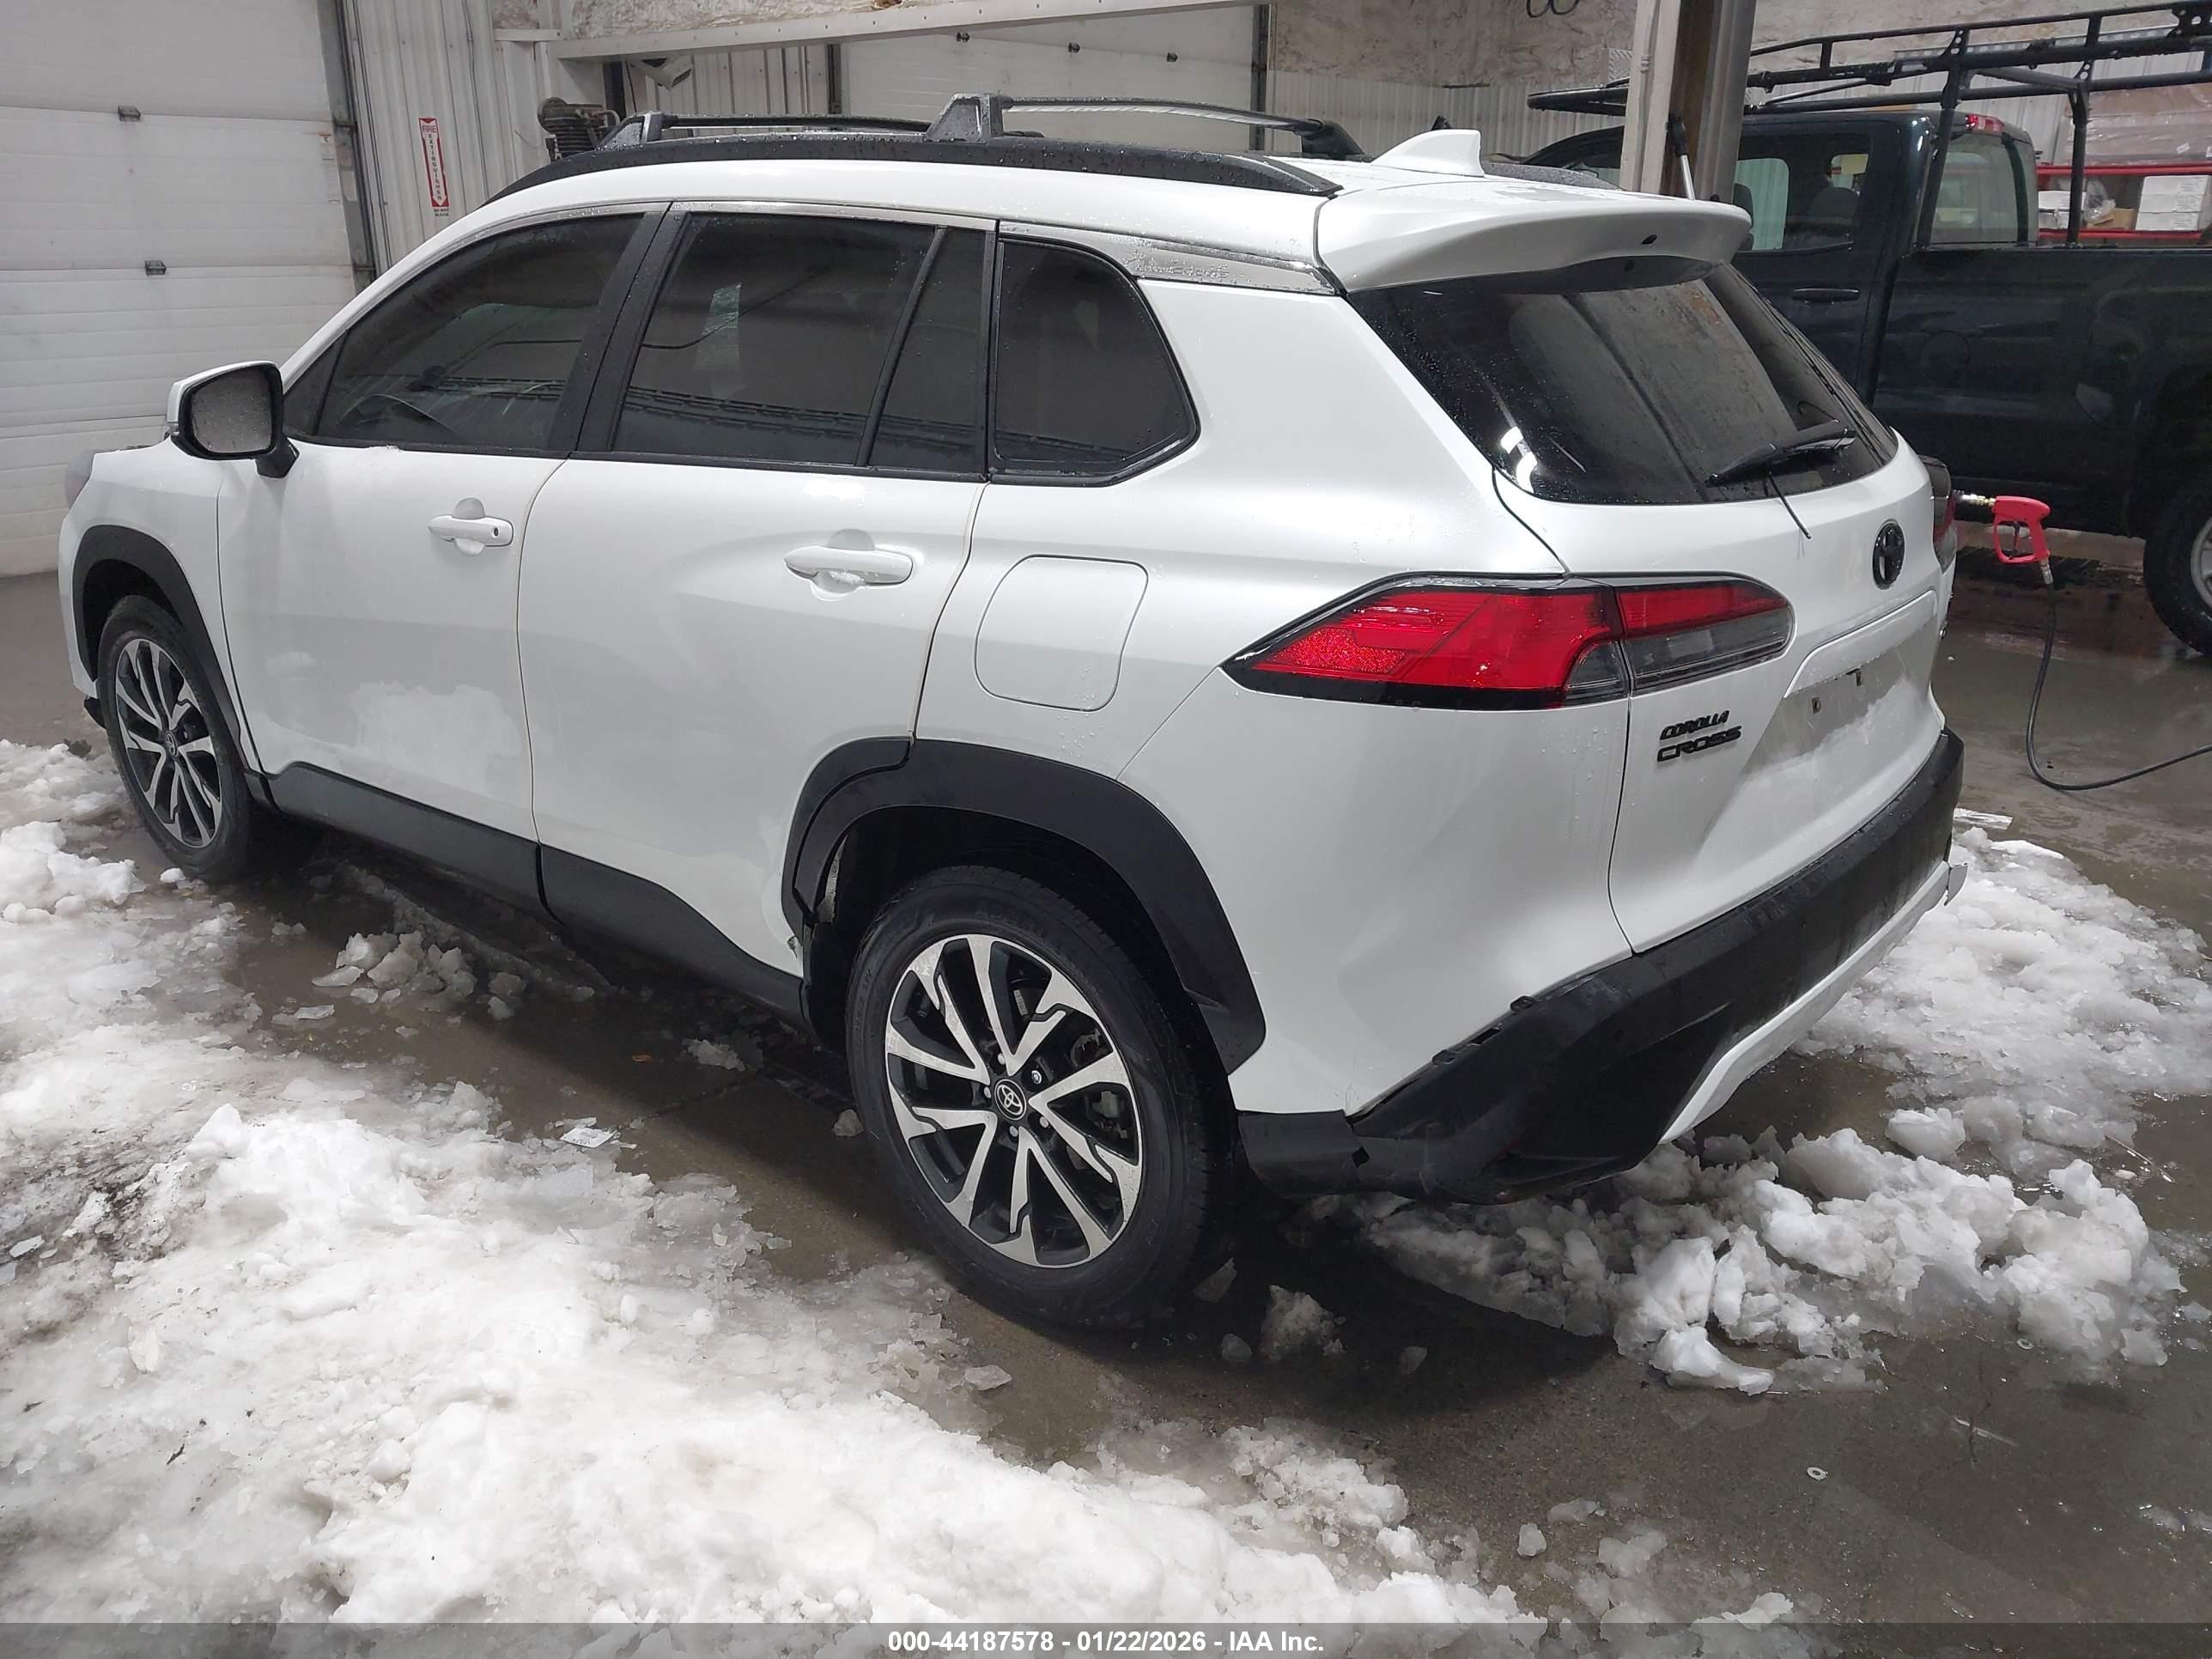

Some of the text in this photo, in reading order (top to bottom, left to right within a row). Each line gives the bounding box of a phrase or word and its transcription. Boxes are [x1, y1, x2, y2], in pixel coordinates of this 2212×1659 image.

[422, 125, 437, 133] FIRE
[428, 134, 442, 200] EXTINGUISHER
[1659, 709, 1730, 740] COROLLA
[1656, 726, 1742, 762] CROSS
